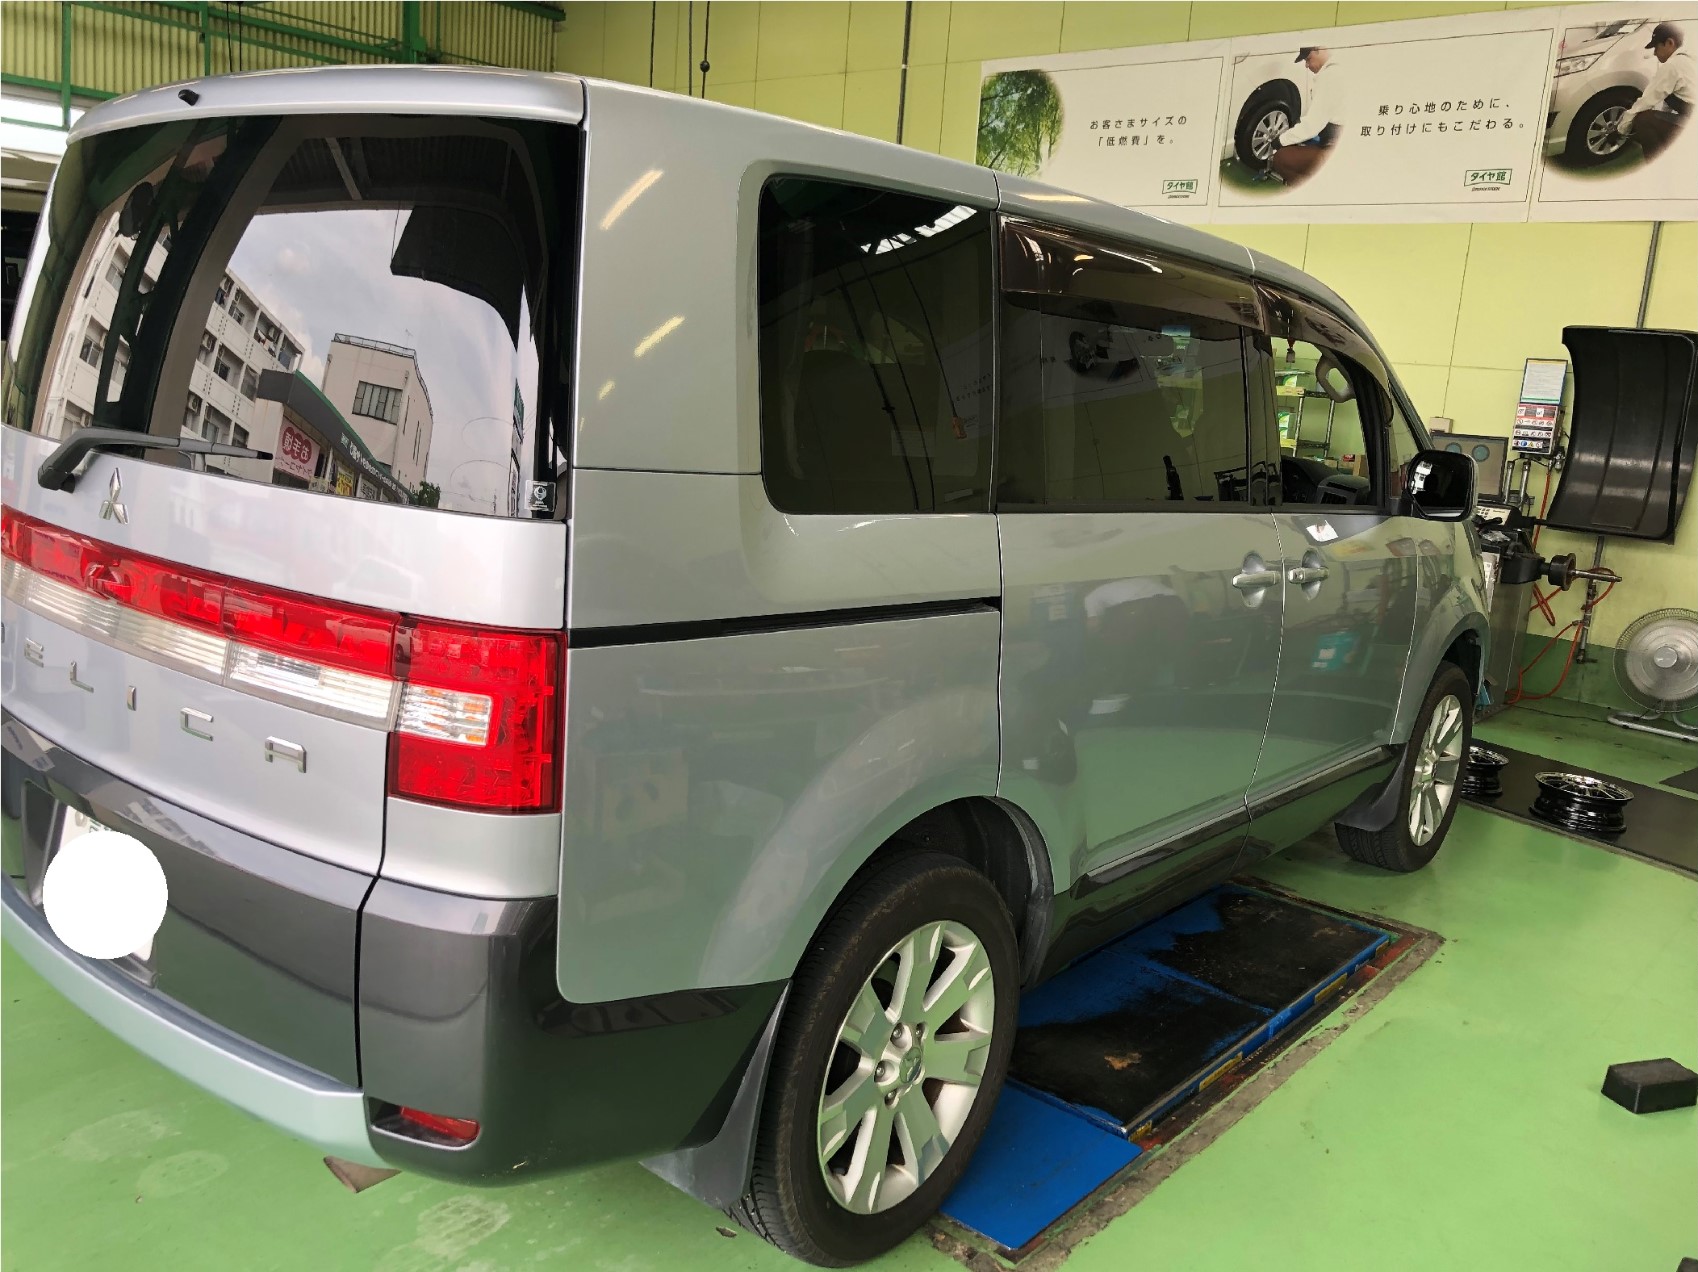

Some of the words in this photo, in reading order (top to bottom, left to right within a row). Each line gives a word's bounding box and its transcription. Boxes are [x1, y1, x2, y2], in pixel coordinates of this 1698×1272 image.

[1378, 97, 1510, 116] 乗り心地のために、
[1090, 115, 1187, 130] お客さまサイズの
[1360, 118, 1524, 137] 取り付けにもこだわる。
[1098, 134, 1174, 147] 「低燃費」を。
[1470, 171, 1507, 182] タイヤ館
